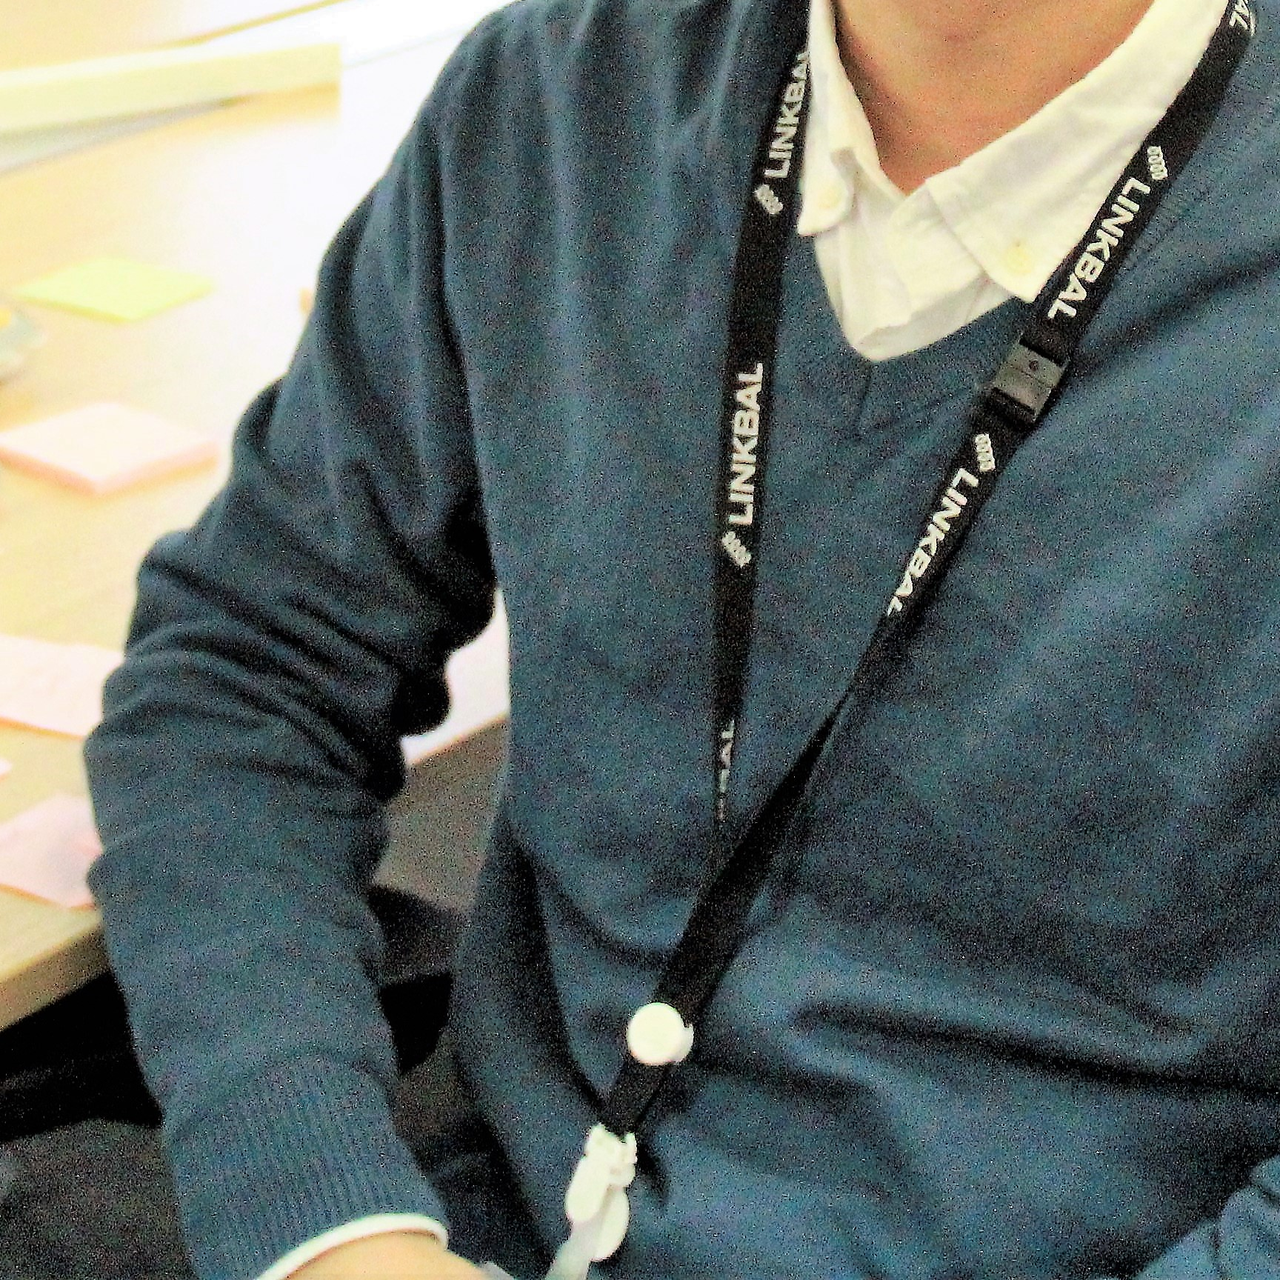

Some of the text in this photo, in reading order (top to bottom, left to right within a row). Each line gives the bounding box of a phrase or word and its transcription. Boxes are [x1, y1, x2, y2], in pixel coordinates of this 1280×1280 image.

[1047, 177, 1151, 319] LINKBAL
[728, 362, 764, 526] LINKBAL
[887, 467, 979, 616] LINKBAL
